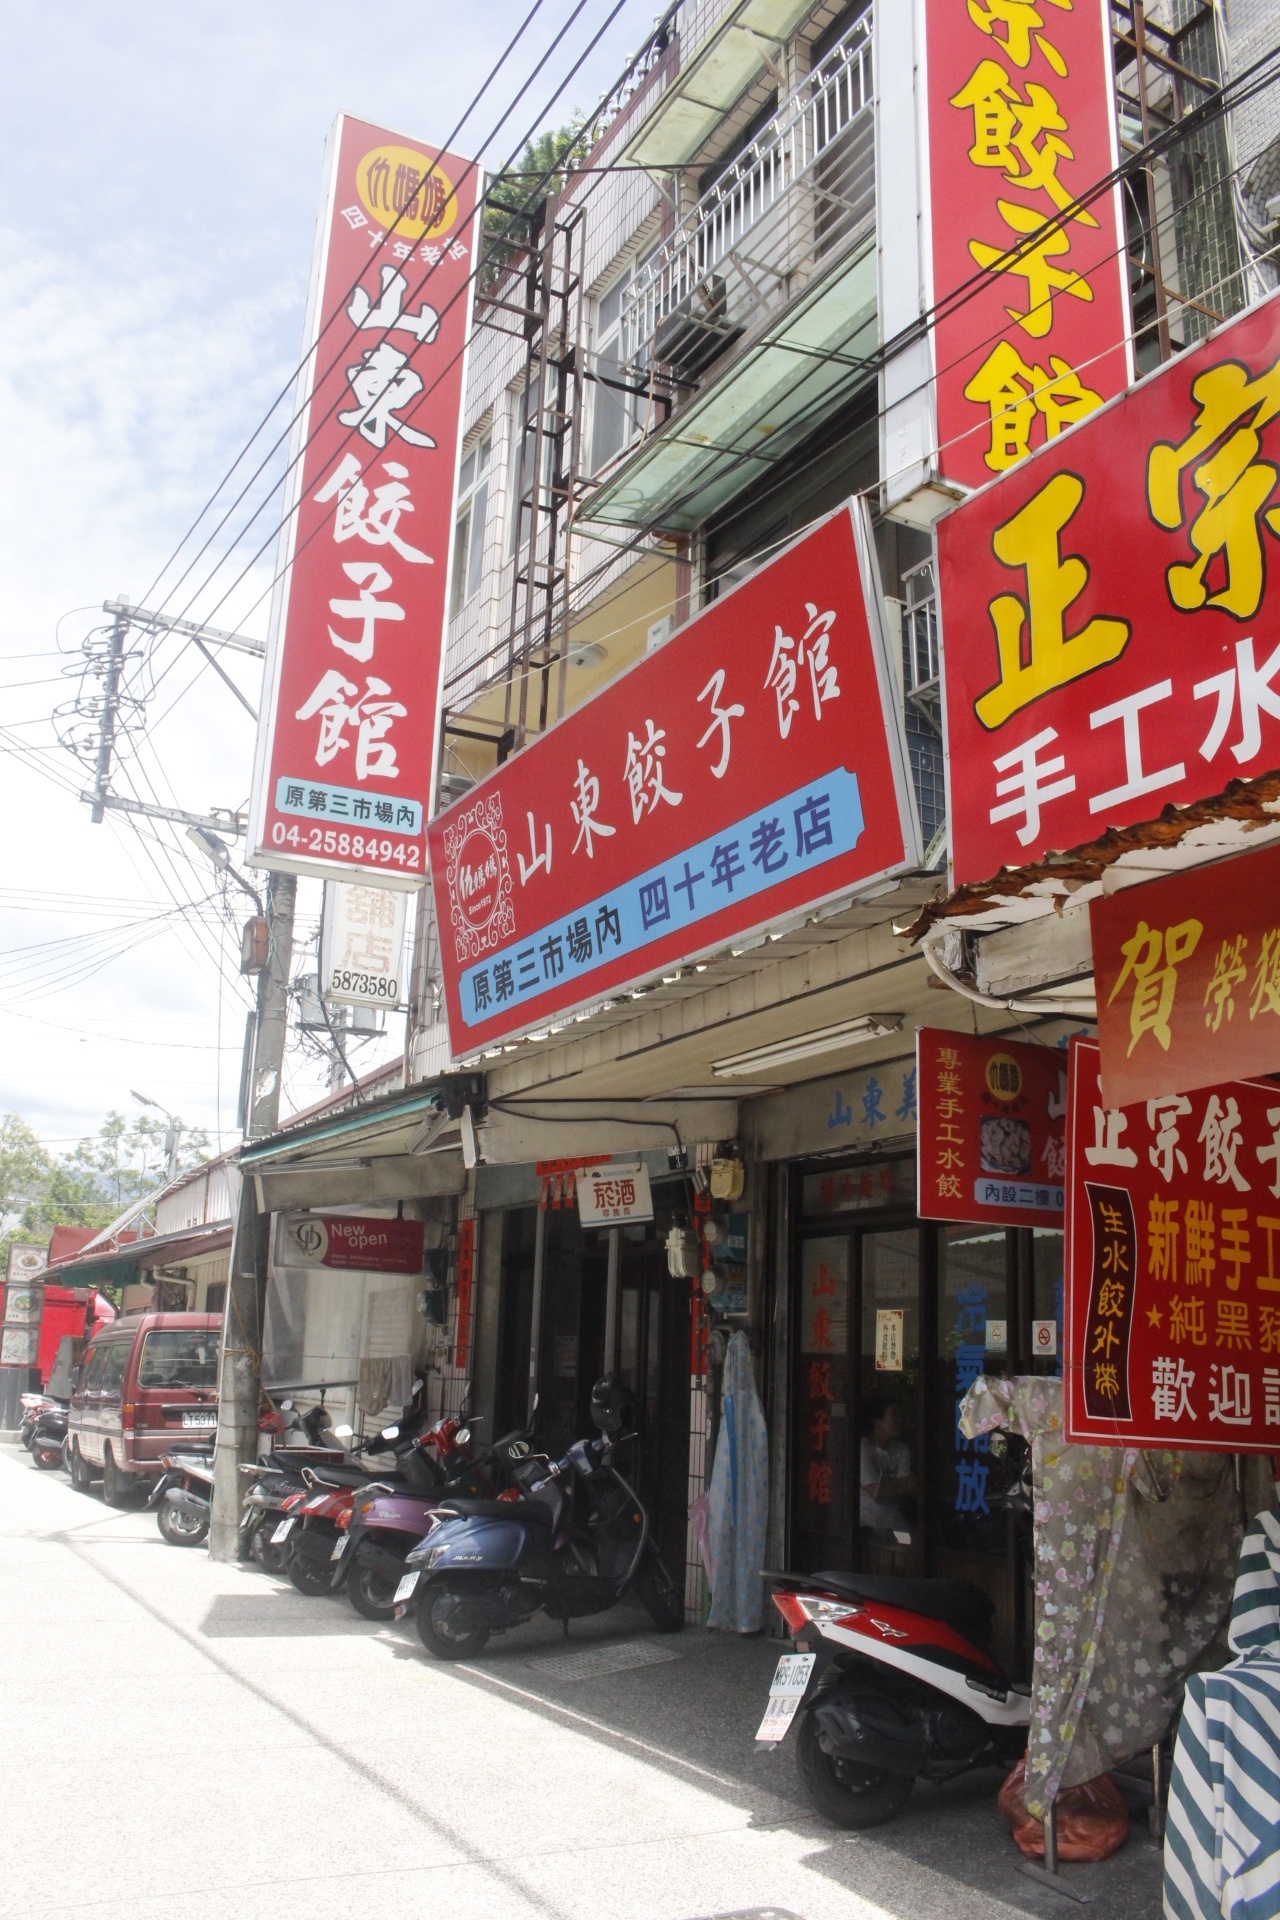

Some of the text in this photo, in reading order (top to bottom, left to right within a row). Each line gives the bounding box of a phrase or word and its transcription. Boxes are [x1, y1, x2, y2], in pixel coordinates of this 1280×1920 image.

[340, 204, 469, 266] 四十年老店
[295, 263, 438, 780] 山東餃子館
[974, 359, 1280, 730] 正宗
[516, 602, 841, 886] 山東餃子館
[990, 637, 1280, 847] 手工水
[271, 821, 421, 869] 04-25884942
[284, 784, 416, 829] 原第三市場內
[638, 793, 834, 932] 四十年老店
[332, 969, 398, 998] 5873580
[472, 904, 621, 1012] 原第三市場內
[1107, 918, 1204, 1058] 賀
[935, 1047, 965, 1199] 專業手工水餃
[331, 1224, 365, 1238] New
[348, 1233, 387, 1249] open
[593, 1178, 636, 1209] 菸酒
[1147, 1192, 1280, 1291] 新鮮手工
[1092, 1201, 1130, 1400] 生水餃外帶
